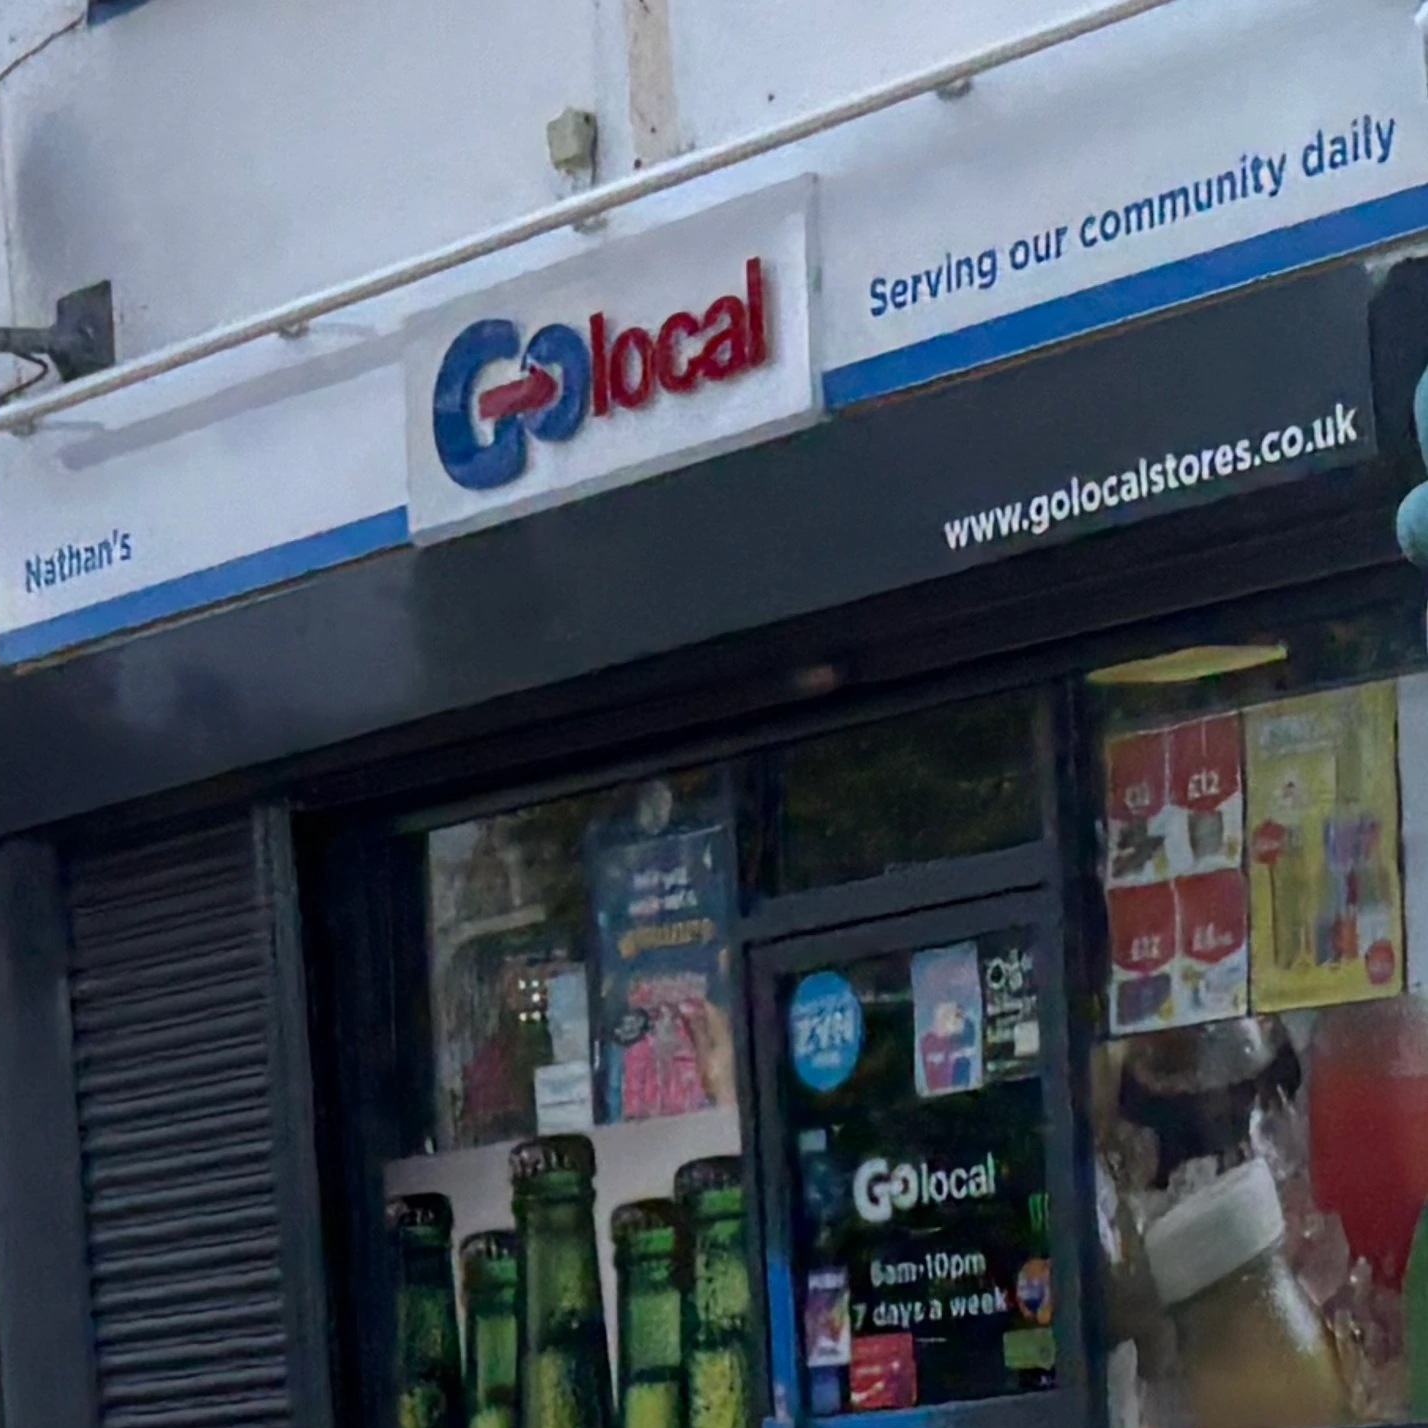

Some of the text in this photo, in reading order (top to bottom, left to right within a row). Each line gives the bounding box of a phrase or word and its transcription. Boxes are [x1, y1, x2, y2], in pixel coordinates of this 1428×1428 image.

[870, 113, 1396, 317] Serving our community daily
[944, 402, 1359, 551] www.golocalstores.co.uk
[25, 528, 132, 594] Nathan's
[949, 1285, 1008, 1318] week
